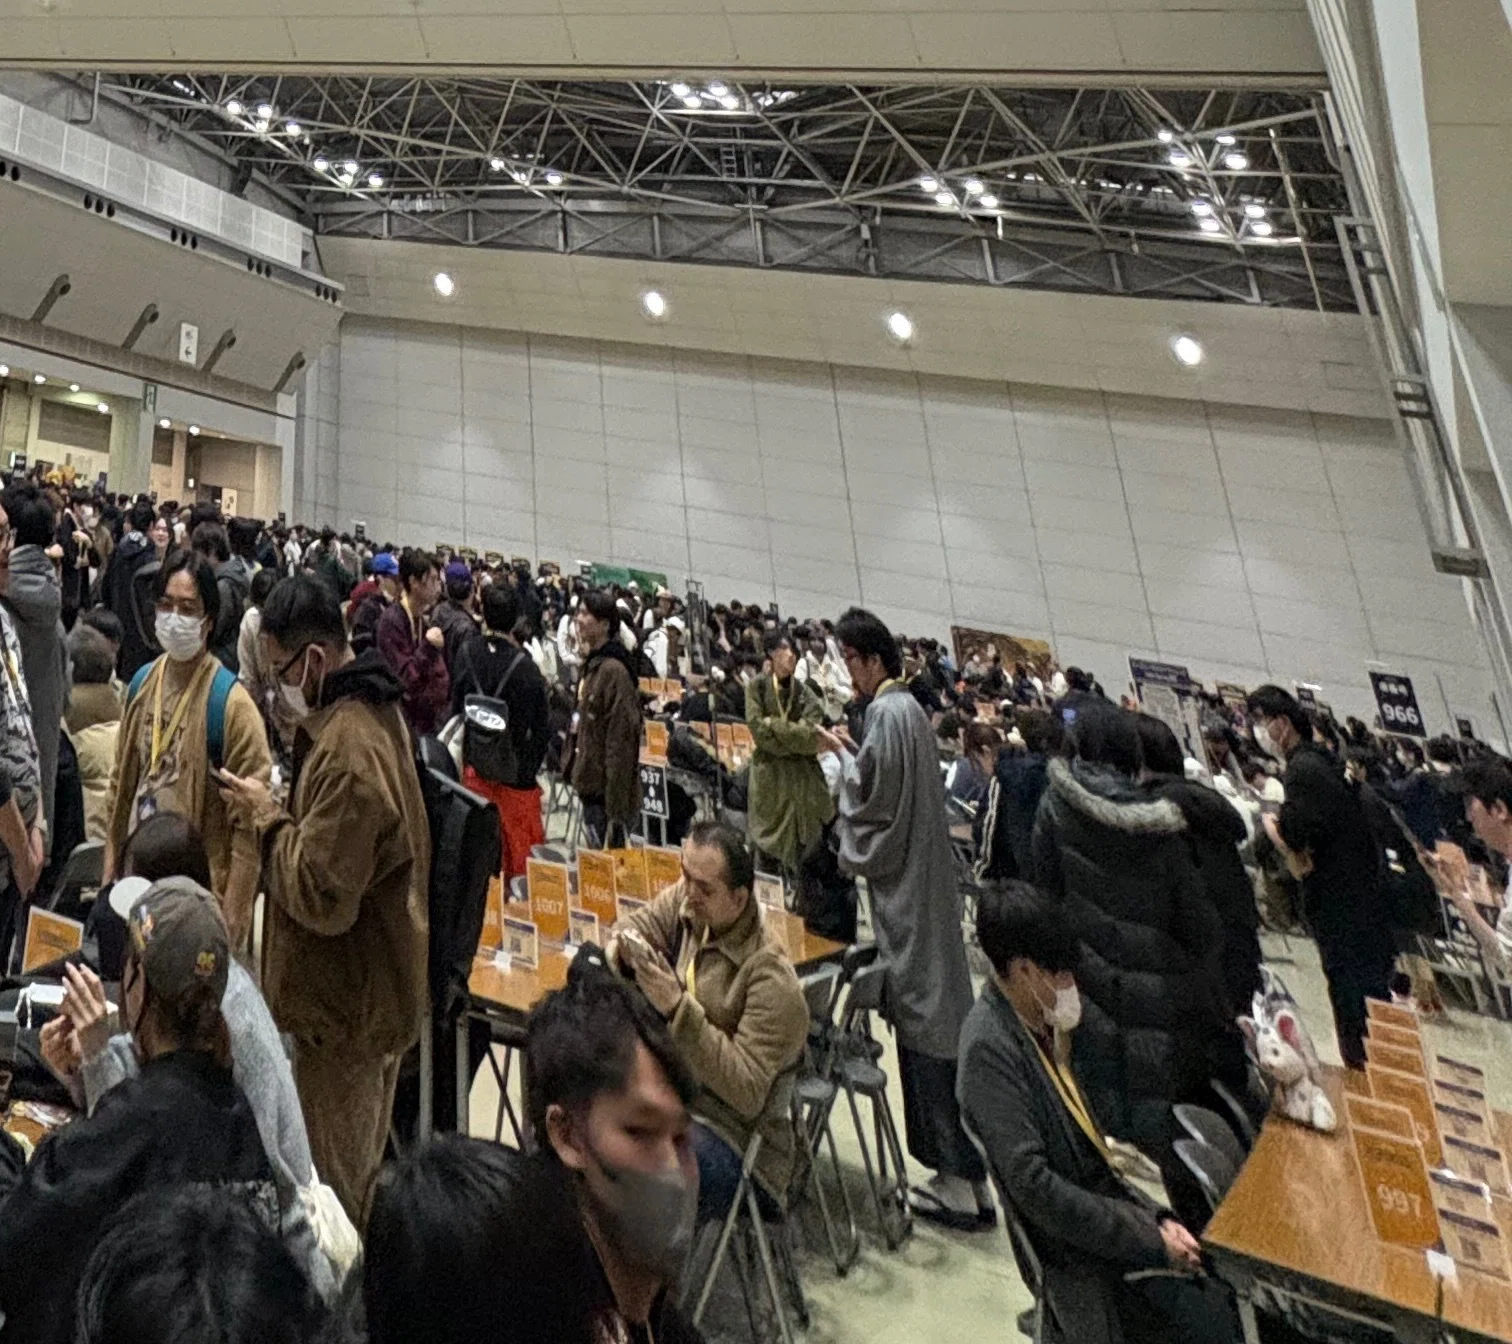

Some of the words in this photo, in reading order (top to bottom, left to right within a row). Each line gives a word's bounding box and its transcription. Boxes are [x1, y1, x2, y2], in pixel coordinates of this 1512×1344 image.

[1382, 703, 1419, 725] 966
[640, 769, 660, 786] 937
[1376, 1183, 1421, 1219] 997
